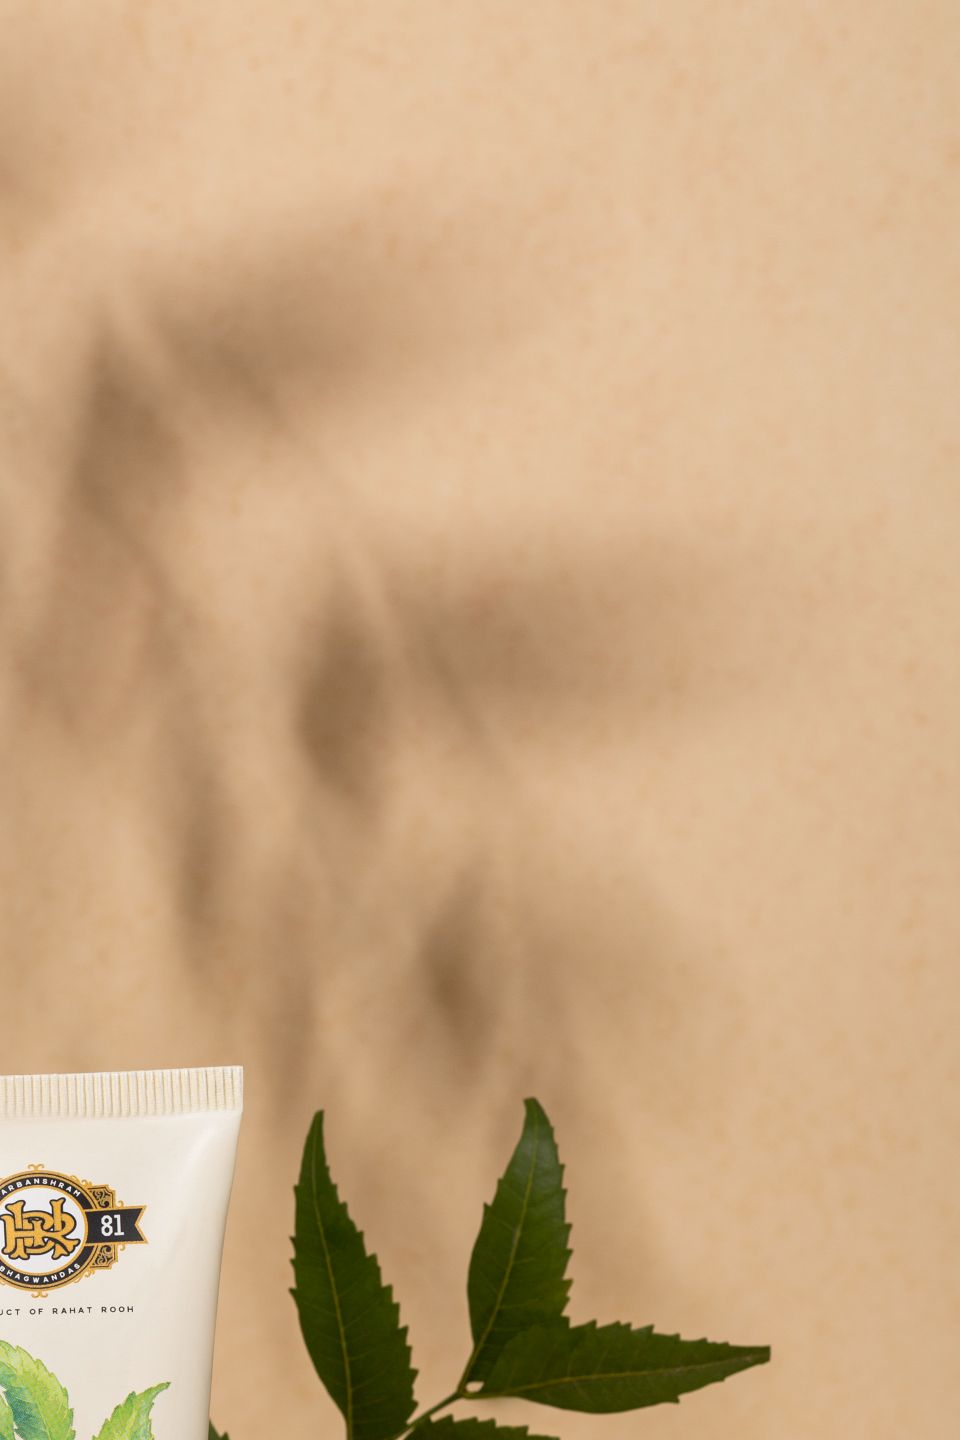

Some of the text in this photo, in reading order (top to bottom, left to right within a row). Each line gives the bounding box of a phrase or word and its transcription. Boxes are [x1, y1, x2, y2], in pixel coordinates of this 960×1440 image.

[100, 1214, 125, 1237] 81
[0, 1263, 80, 1283] BHAGWANDAS
[52, 1306, 92, 1315] RAHAT
